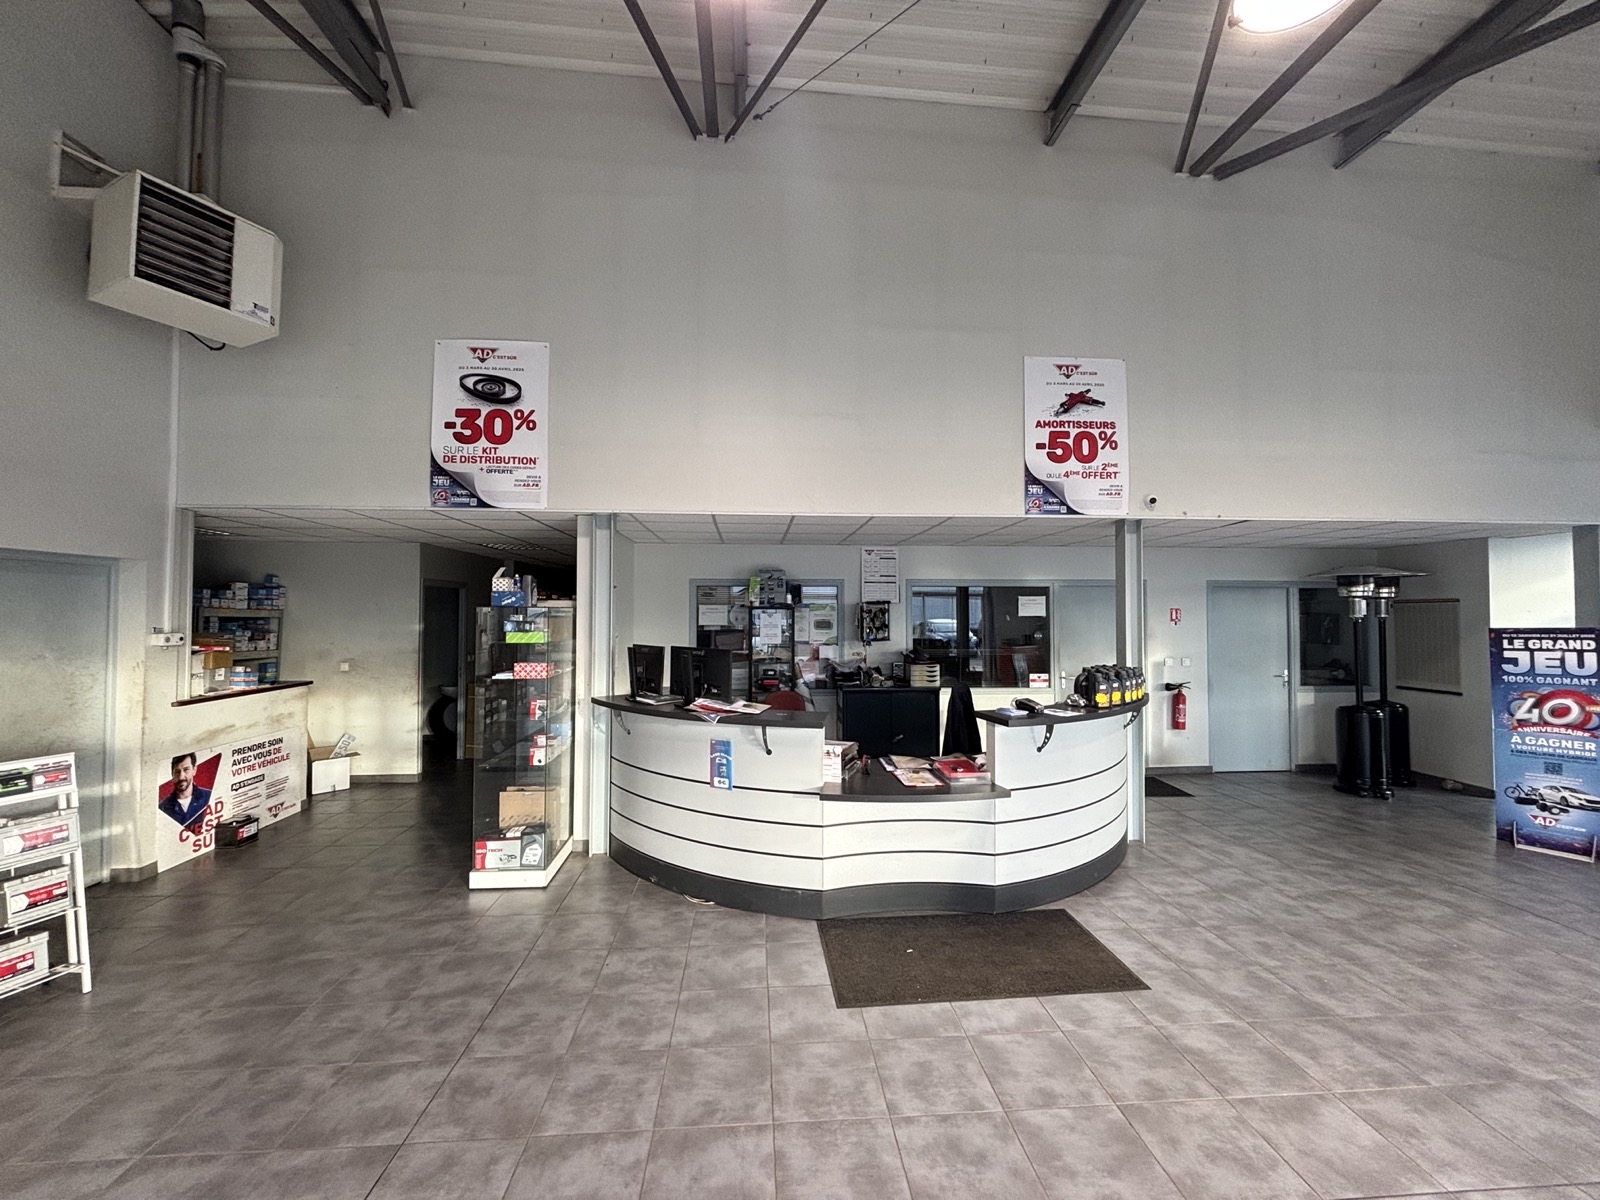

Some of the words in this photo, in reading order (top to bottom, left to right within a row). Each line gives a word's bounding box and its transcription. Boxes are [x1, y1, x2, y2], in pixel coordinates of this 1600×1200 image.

[475, 349, 492, 359] AD
[1061, 366, 1076, 375] AD
[444, 408, 537, 445] -30%
[1035, 420, 1116, 429] AMORTISSEURS
[443, 446, 464, 454] SUR
[467, 446, 479, 455] LE
[482, 447, 499, 455] KIT
[1036, 431, 1118, 464] -50%
[443, 455, 457, 463] DE
[1503, 639, 1525, 648] LE
[1528, 639, 1596, 650] GRAND
[1501, 651, 1598, 676] JEU
[1502, 675, 1534, 683] 100%
[1536, 677, 1598, 686] GAGNANT
[1515, 698, 1579, 725] 40
[1517, 727, 1591, 737] ANNIVERSAIRE
[232, 741, 266, 757] PRENDRE
[268, 737, 283, 747] SOIN
[1511, 733, 1522, 743] À
[1525, 737, 1596, 750] GAGNER
[232, 755, 252, 767] AVEC
[253, 749, 272, 760] VOUS
[273, 746, 282, 755] DE
[1556, 748, 1597, 757] HYBRIDE
[232, 763, 256, 777] VOTRE
[257, 753, 290, 769] VÉHICULE
[203, 800, 224, 818] AD
[271, 804, 282, 814] AD
[179, 814, 223, 842] C'EST
[1535, 816, 1556, 826] AD
[192, 833, 213, 853] SÛ
